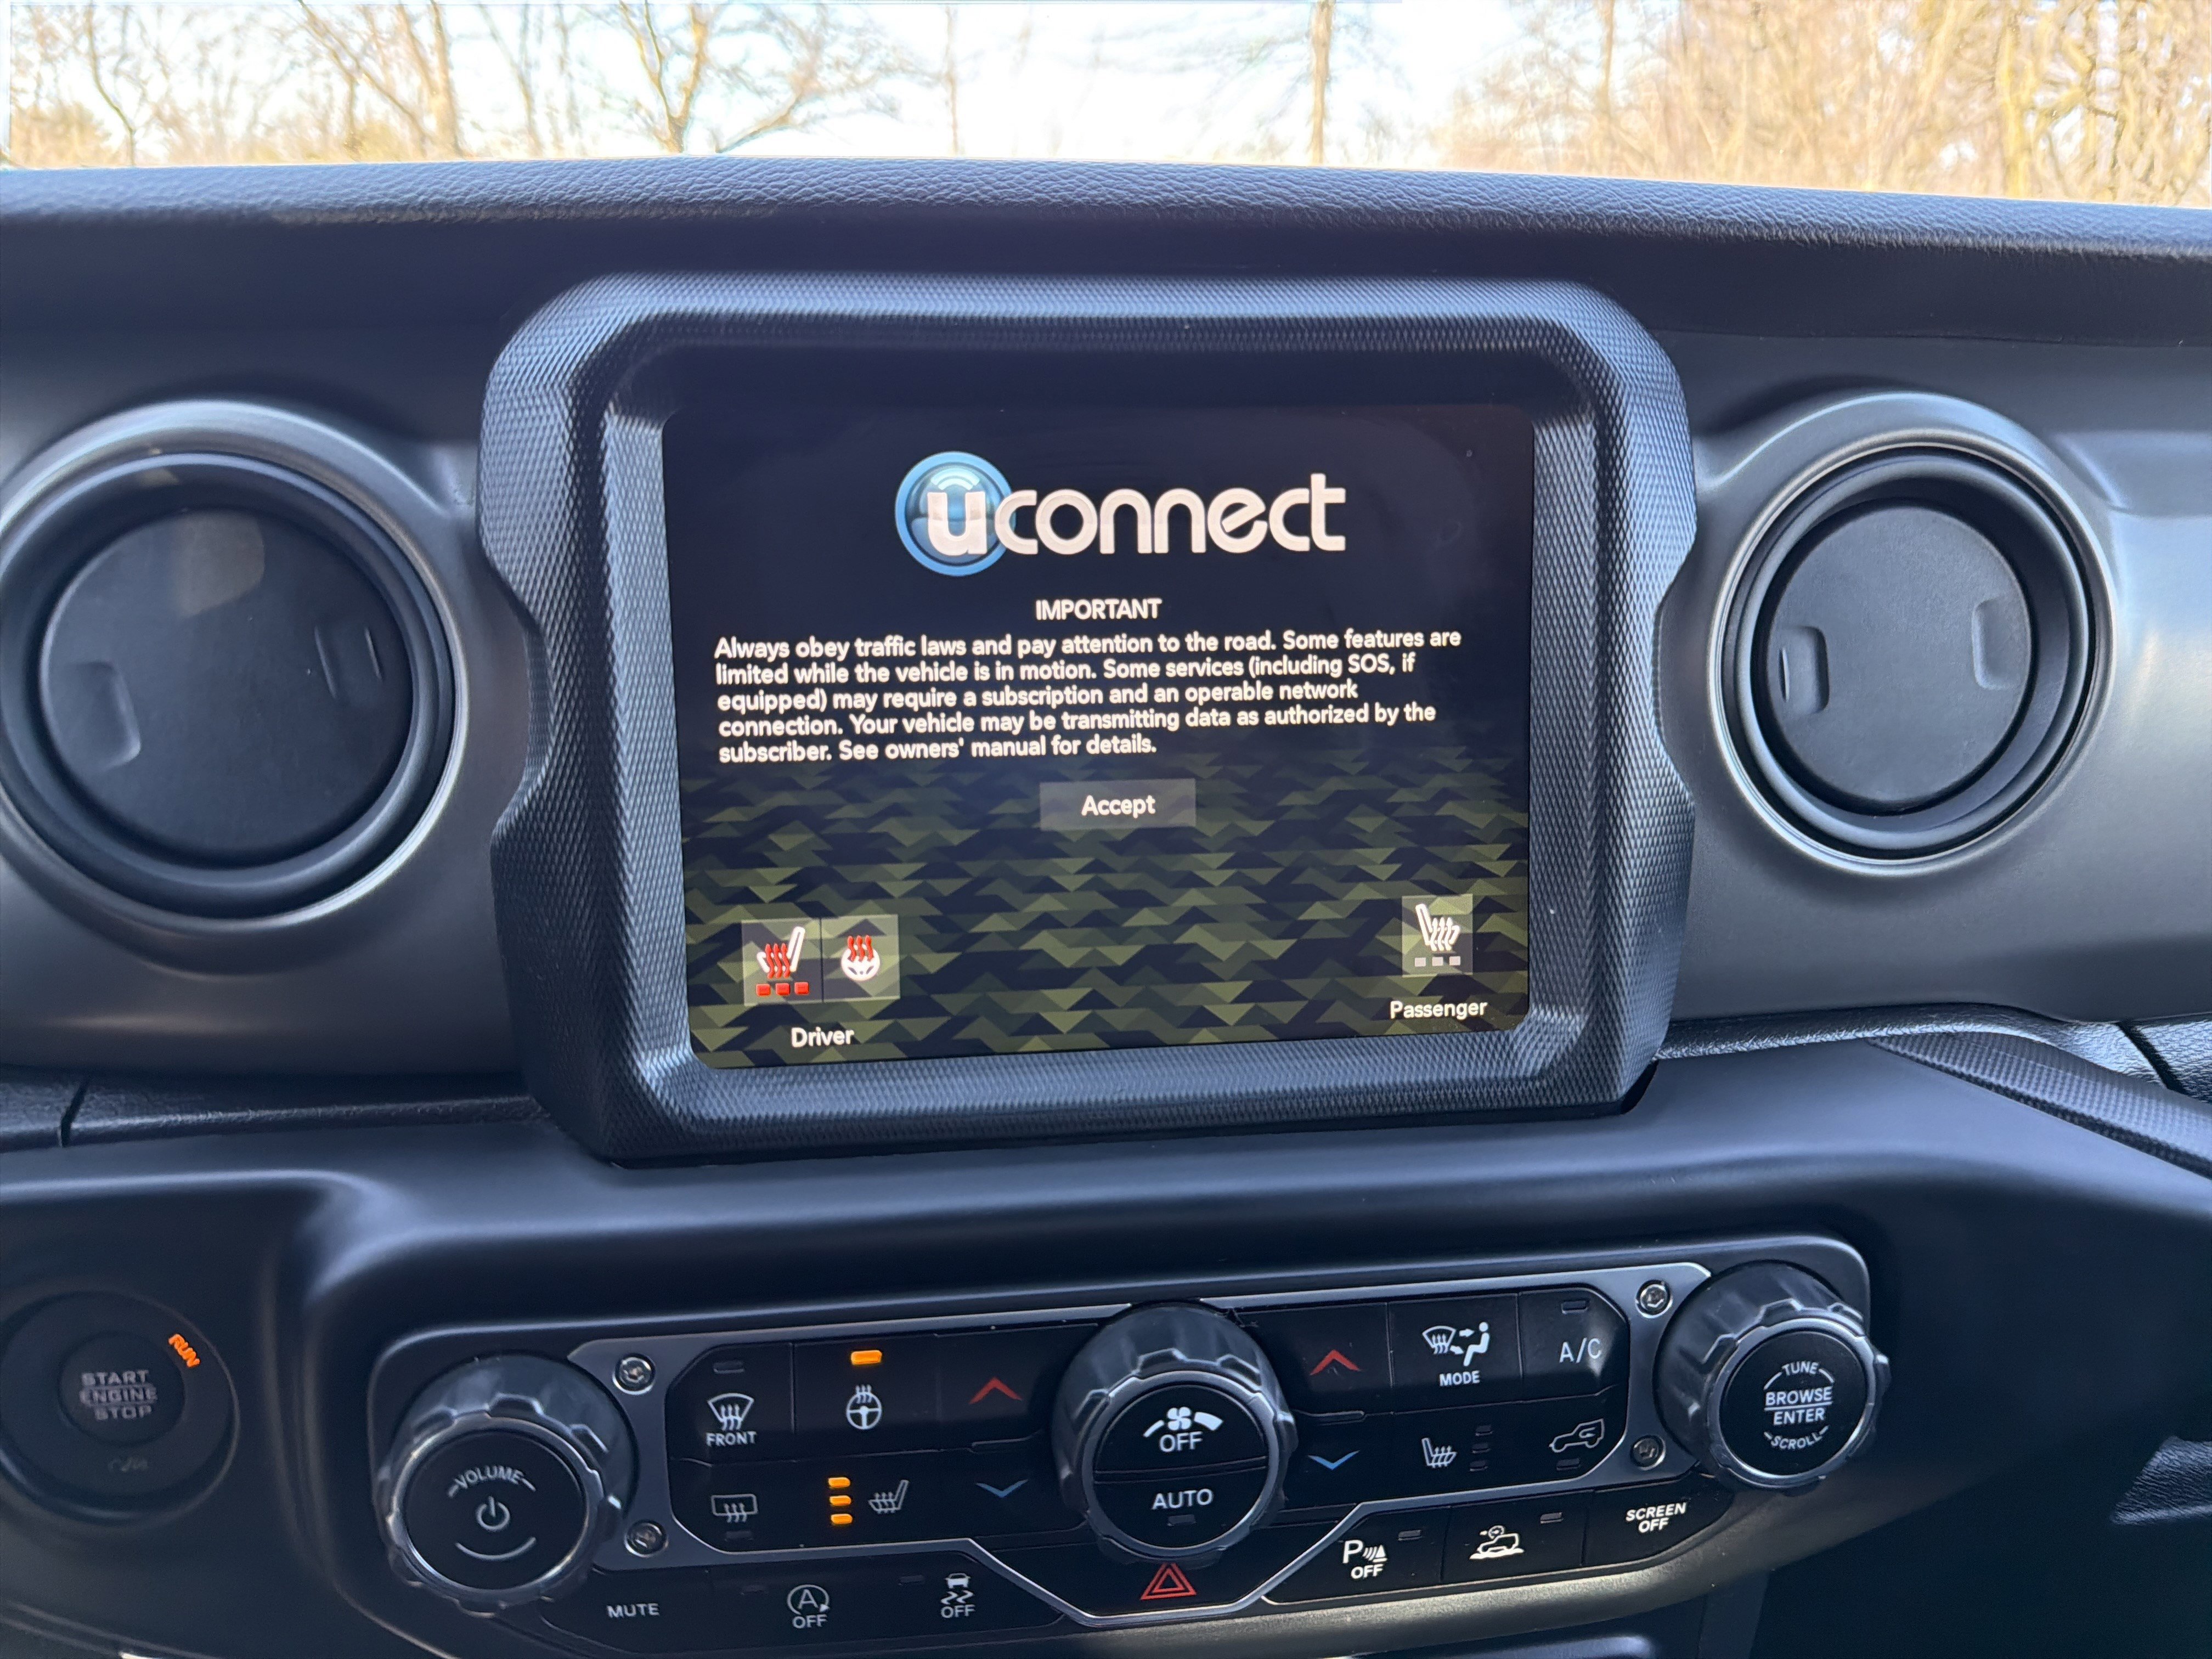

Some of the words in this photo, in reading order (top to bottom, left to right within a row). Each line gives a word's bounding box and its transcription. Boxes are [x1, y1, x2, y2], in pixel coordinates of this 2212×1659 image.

[926, 472, 1347, 557] uconnect
[1035, 597, 1163, 621] IMPORTANT
[713, 636, 791, 663] Always
[794, 635, 850, 662] obey
[854, 634, 916, 658] traffic
[921, 634, 967, 657] laws
[972, 633, 1012, 656] and
[1017, 639, 1057, 659] pay
[1061, 633, 1154, 654] attention
[1157, 634, 1181, 652] to
[1184, 630, 1219, 652] the
[1224, 629, 1277, 651] road.
[1283, 629, 1339, 650] Some
[1344, 627, 1425, 649] features
[1430, 631, 1462, 647] are
[716, 662, 788, 685] limited
[793, 661, 849, 684] while
[855, 661, 890, 683] the
[896, 659, 968, 682] vehicle
[974, 659, 990, 681] is
[995, 659, 1014, 680] in
[1019, 659, 1096, 680] motion.
[1103, 658, 1160, 680] Some
[1165, 657, 1244, 678] services
[1248, 654, 1342, 680] (including
[1347, 653, 1395, 675] SOS,
[1402, 653, 1415, 673] if
[717, 689, 827, 714] equipped)
[832, 692, 878, 712] may
[883, 687, 957, 712] require
[963, 691, 977, 707] a
[981, 685, 1103, 709] subscription
[1109, 682, 1148, 704] and
[1154, 686, 1180, 703] an
[1185, 680, 1274, 704] operable
[1279, 679, 1358, 700] network
[719, 715, 843, 737] connection.
[849, 714, 898, 735] Your
[902, 712, 974, 733] vehicle
[980, 713, 1024, 735] may
[1029, 711, 1057, 731] be
[1062, 709, 1180, 731] transmitting
[1185, 707, 1231, 727] data
[1236, 710, 1260, 726] as
[1264, 704, 1369, 725] authorized
[1374, 703, 1400, 726] by
[1403, 701, 1437, 722] the
[719, 741, 832, 763] subscriber.
[838, 740, 879, 760] See
[884, 738, 964, 759] owners'
[971, 735, 1045, 757] manual
[1051, 734, 1081, 755] for
[1086, 733, 1157, 755] details.
[1081, 795, 1156, 819] Accept
[1390, 1000, 1488, 1020] Passenger
[791, 1026, 855, 1048] Driver
[168, 1333, 201, 1368] RUN
[1559, 1337, 1602, 1364] A/C
[81, 1369, 150, 1386] START
[1438, 1370, 1481, 1387] MODE
[1781, 1360, 1820, 1377] TUNE
[80, 1387, 158, 1403] ENGINE
[1765, 1385, 1833, 1406] BROWSE
[94, 1404, 153, 1420] STOP
[1773, 1407, 1826, 1426] ENTER
[706, 1431, 757, 1447] FRONT
[1159, 1431, 1203, 1453] OFF
[1770, 1431, 1822, 1450] SCROLL
[454, 1465, 524, 1491] VOLUME
[1151, 1488, 1214, 1510] AUTO
[1625, 1501, 1688, 1522] SCREEN
[1638, 1517, 1669, 1533] OFF
[1342, 1539, 1363, 1564] P
[1350, 1564, 1384, 1580] OFF
[607, 1603, 659, 1619] MUTE
[792, 1614, 828, 1629] OFF
[940, 1604, 975, 1619] OFF
